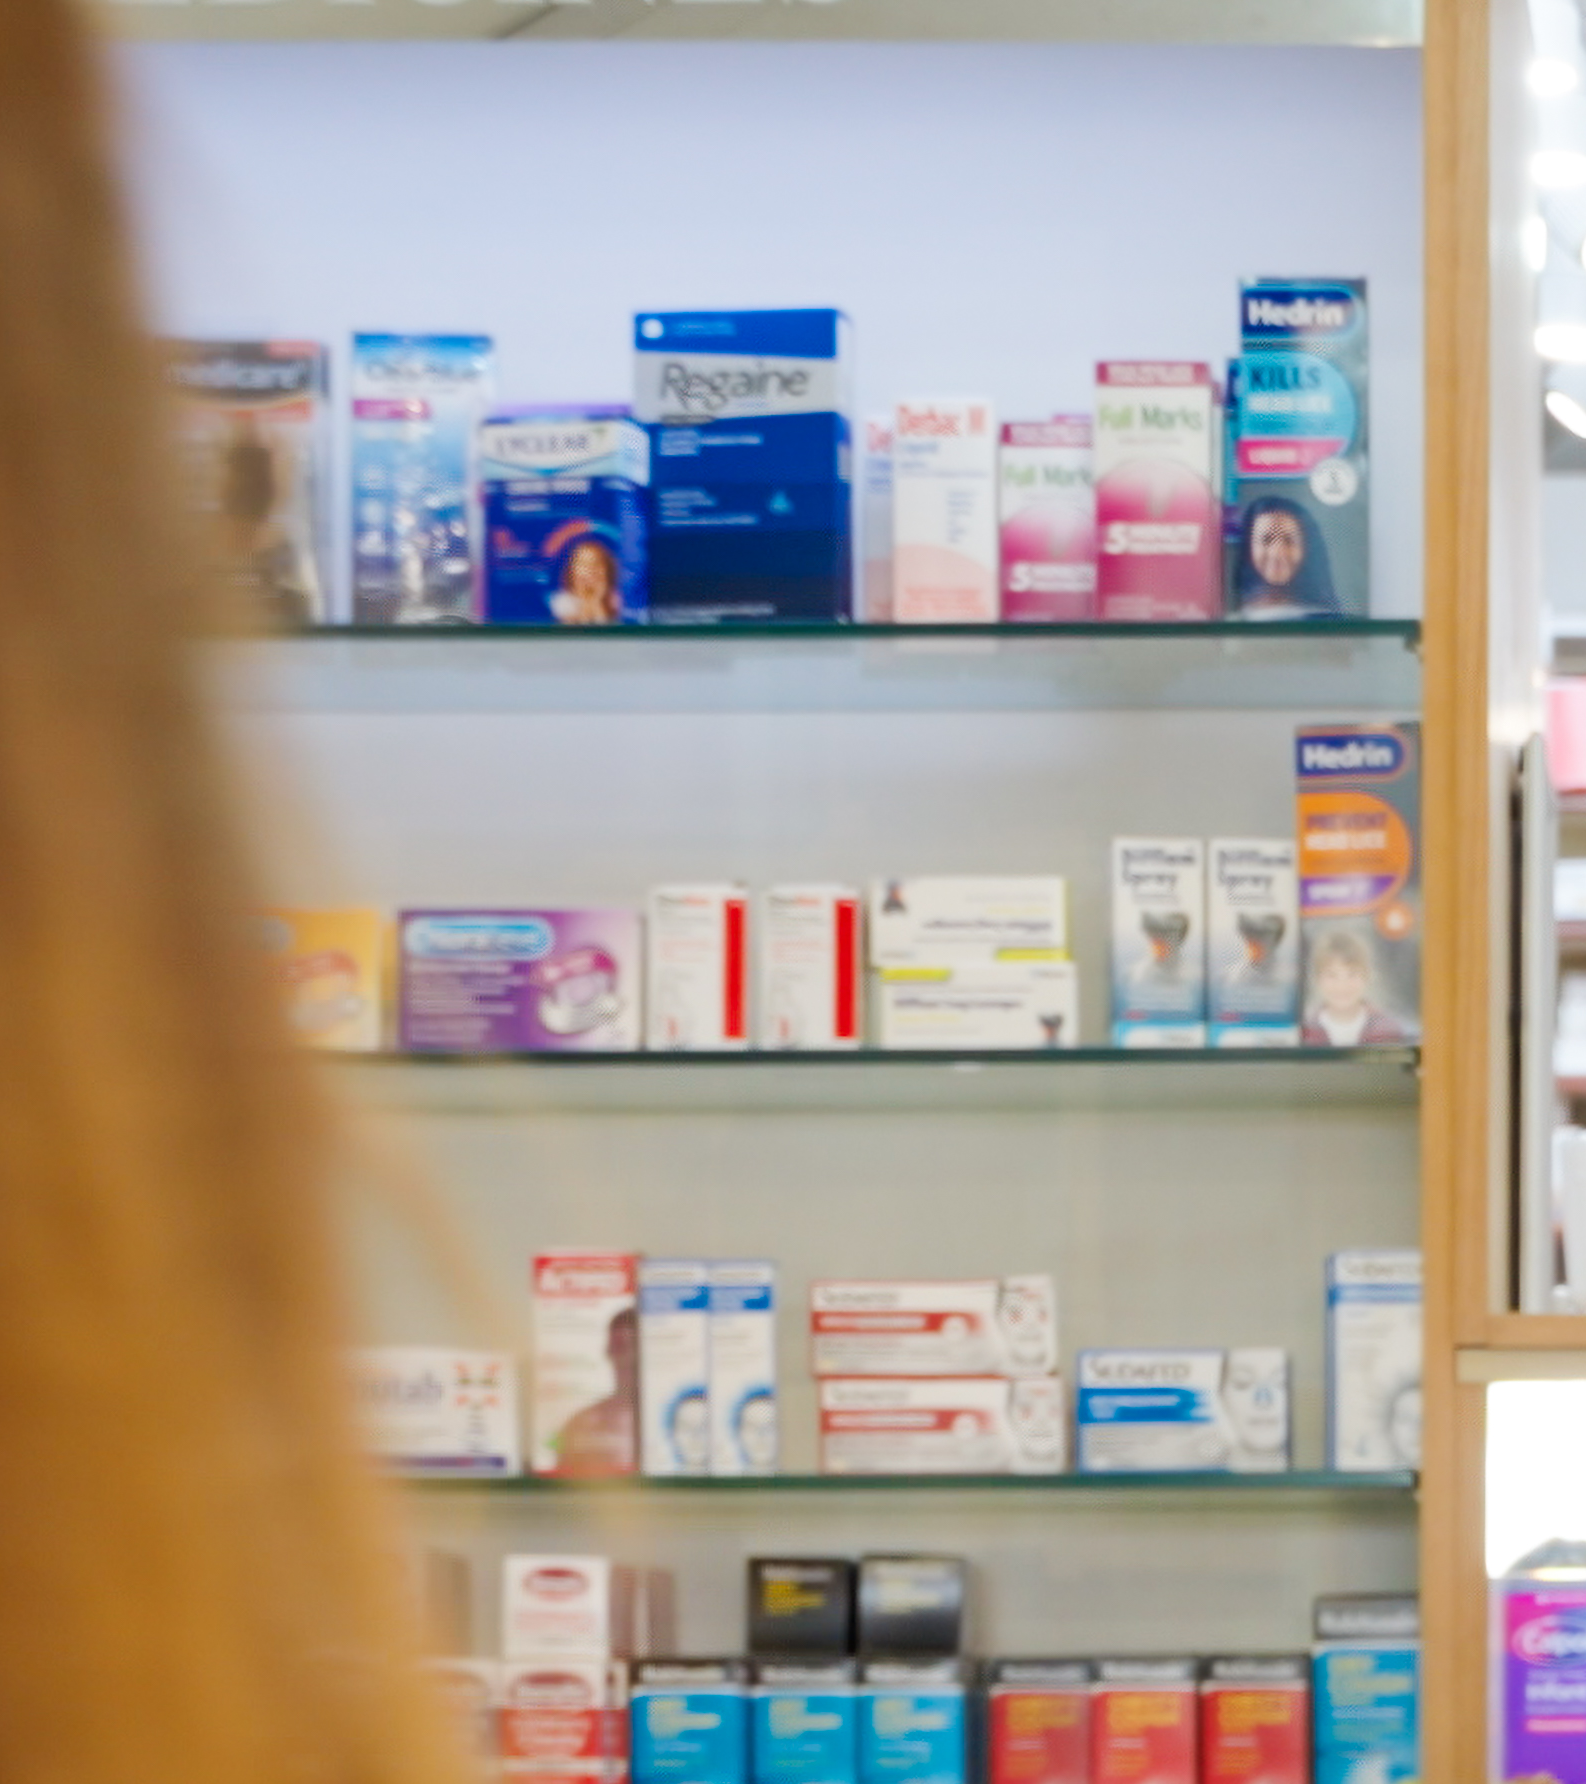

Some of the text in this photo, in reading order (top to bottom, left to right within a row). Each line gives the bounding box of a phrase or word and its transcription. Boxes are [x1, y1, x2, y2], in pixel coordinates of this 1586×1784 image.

[1249, 298, 1344, 328] Hedrin
[661, 360, 810, 411] Regaine
[1250, 365, 1321, 390] KILLS
[1098, 402, 1204, 433] Full Marks
[1302, 741, 1393, 770] Hedrin
